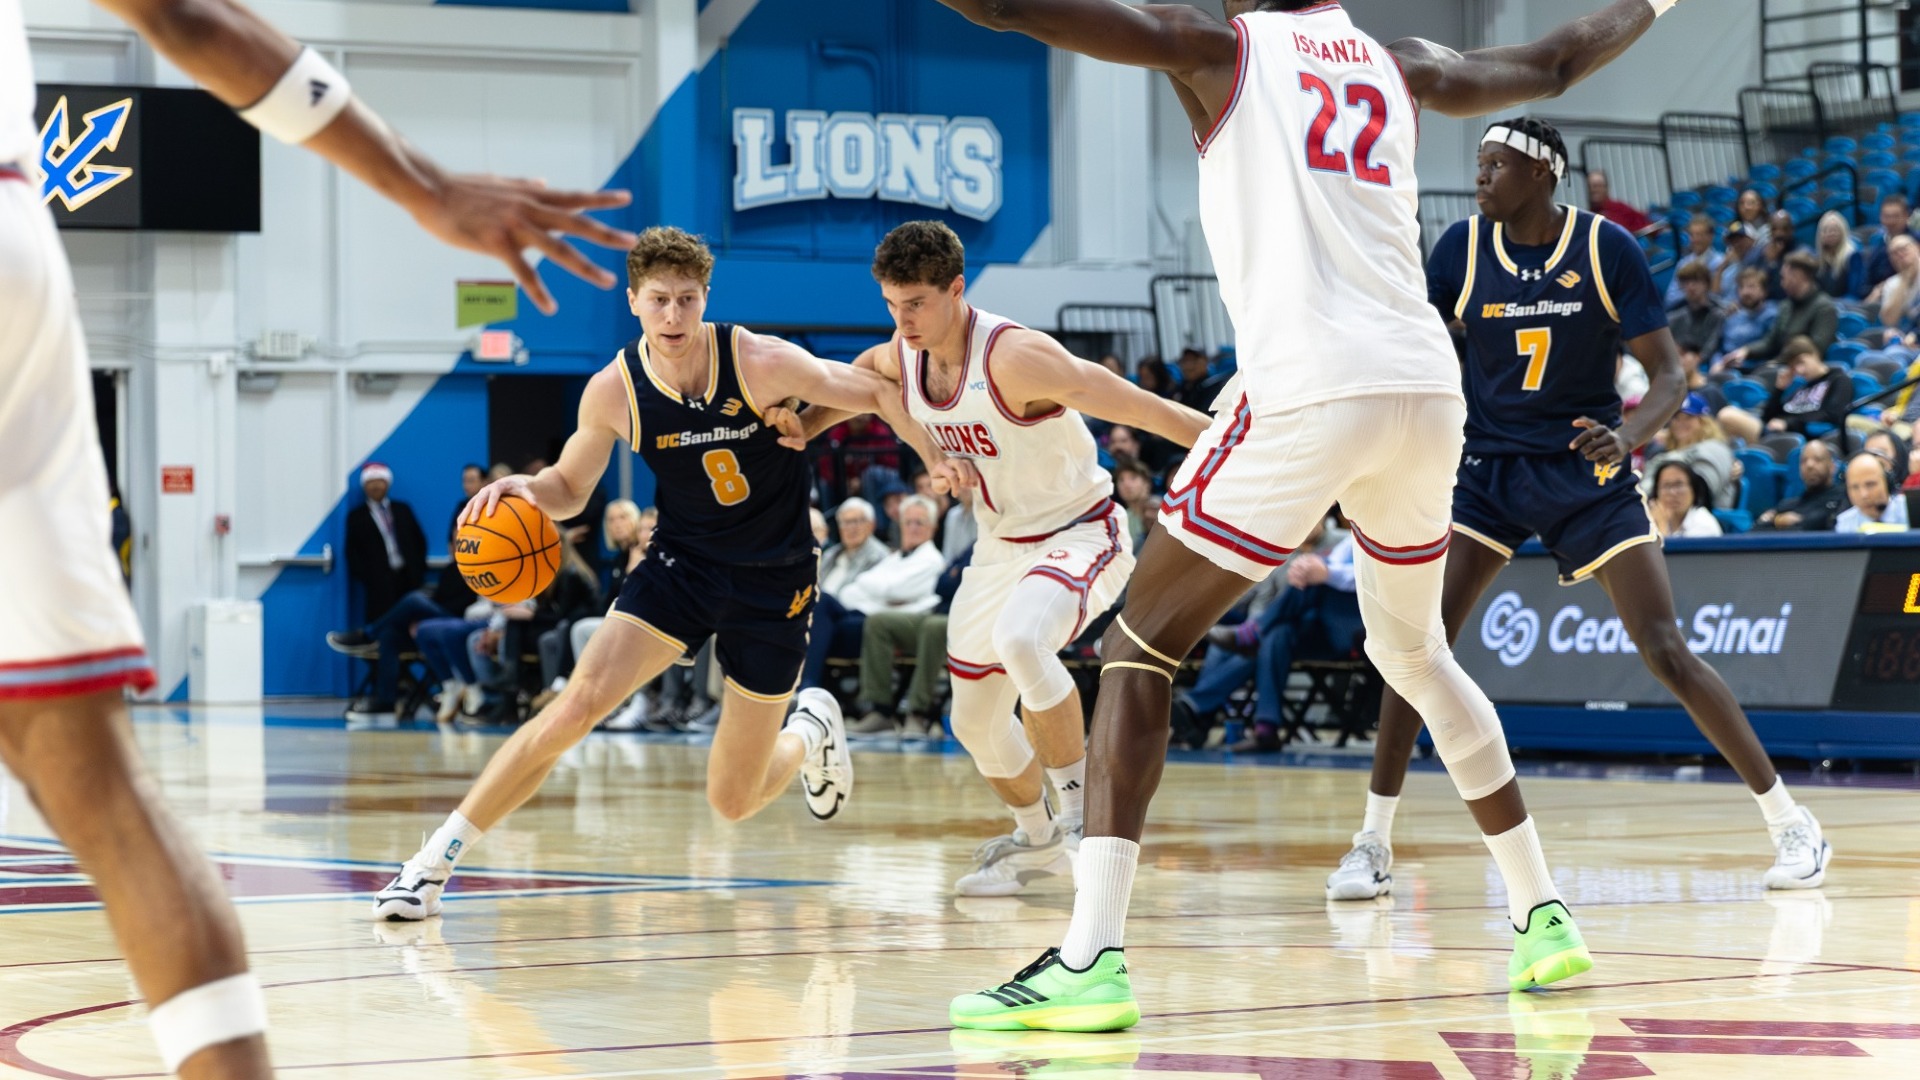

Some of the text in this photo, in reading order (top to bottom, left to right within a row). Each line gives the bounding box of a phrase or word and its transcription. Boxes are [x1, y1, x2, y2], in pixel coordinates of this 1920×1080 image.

[1293, 31, 1373, 66] ISSANZA
[1297, 71, 1393, 188] 22
[733, 107, 1003, 222] LIONS
[1515, 326, 1552, 391] 7
[926, 420, 1000, 460] IONS
[702, 448, 750, 507] 8
[1548, 602, 1793, 654] Ced Sinai
